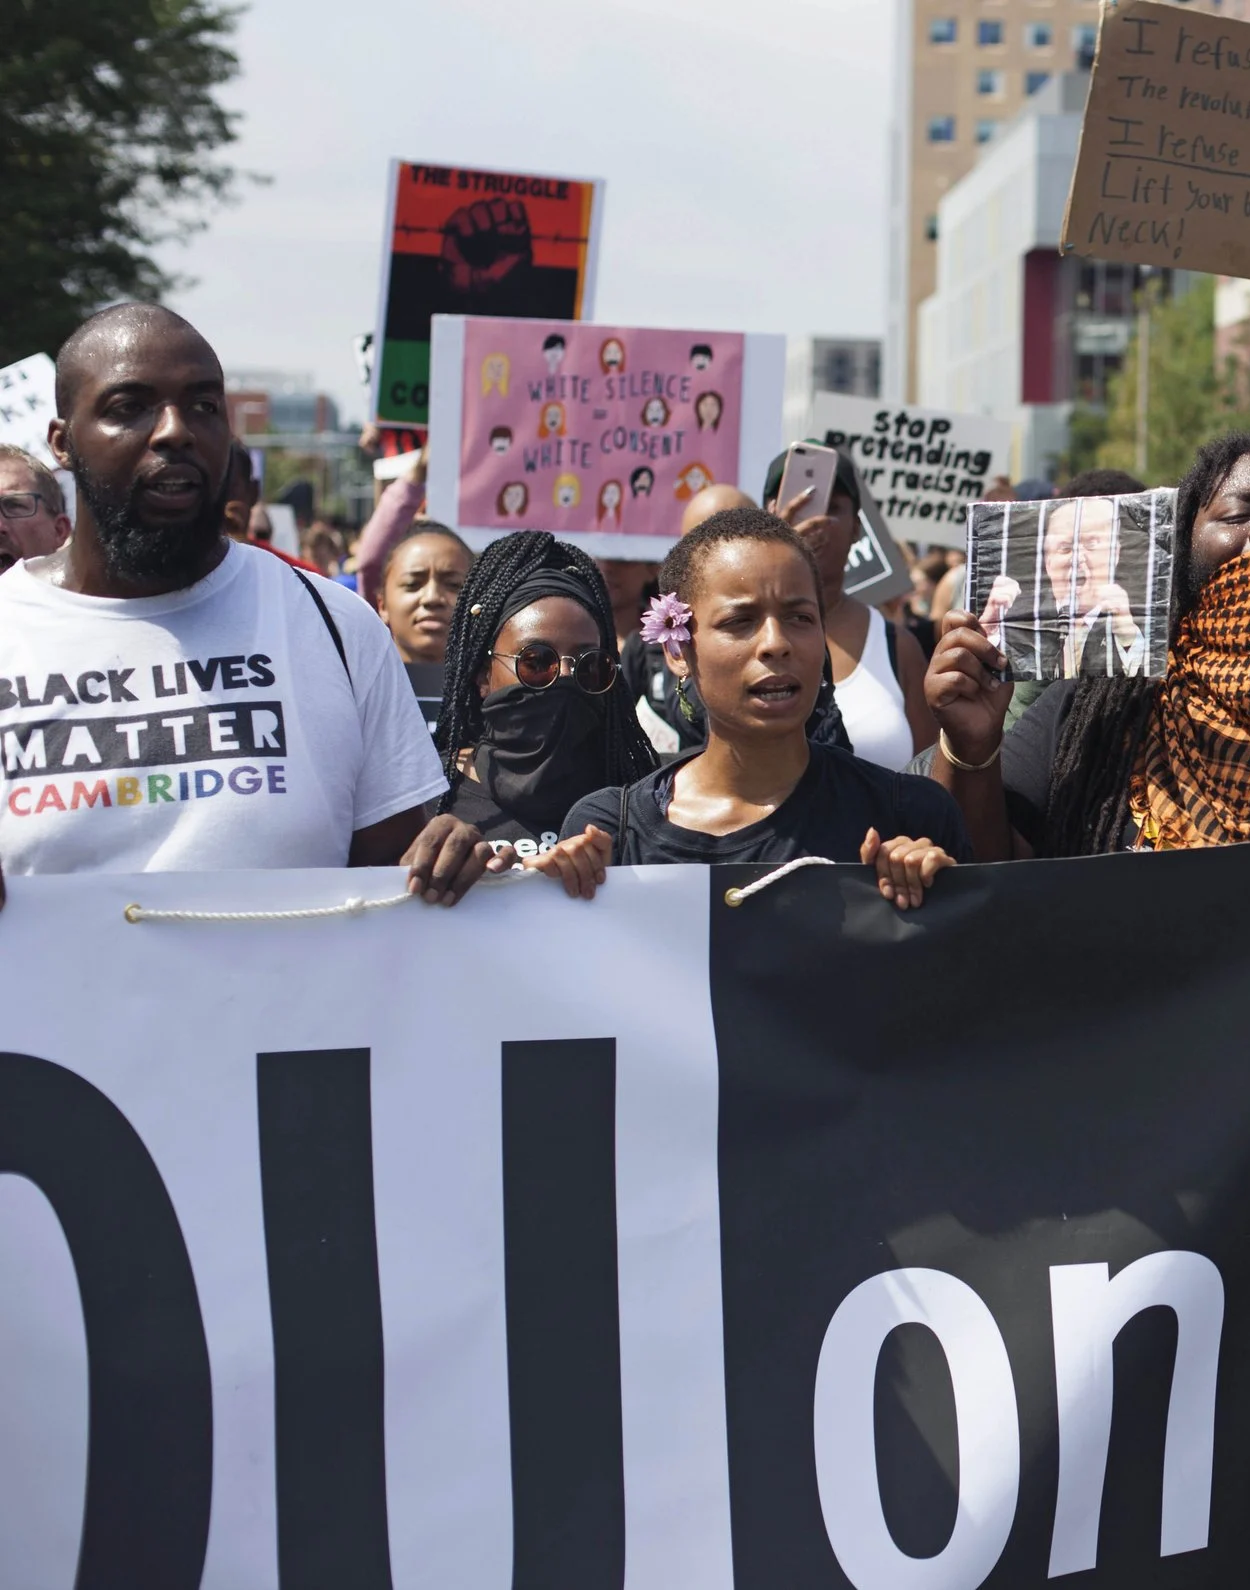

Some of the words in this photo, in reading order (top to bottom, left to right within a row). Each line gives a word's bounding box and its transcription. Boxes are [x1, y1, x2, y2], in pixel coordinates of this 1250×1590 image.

[1122, 17, 1159, 55] I
[1117, 75, 1168, 101] The
[1107, 116, 1145, 146] I
[1158, 124, 1240, 167] refuse
[409, 165, 450, 188] THE
[457, 170, 569, 201] STRUGGLE
[1101, 161, 1174, 205] Lift
[1185, 180, 1234, 214] your
[528, 375, 591, 403] WHITE
[605, 371, 692, 403] SILENCE
[523, 438, 593, 473] WHITE
[600, 425, 686, 461] CONSENT
[825, 429, 992, 476] pretending
[891, 467, 985, 499] racism
[0, 667, 140, 711] BLACK
[152, 654, 276, 698] LIVES
[4, 709, 281, 771] MATTER
[8, 765, 287, 817] CAMBRIDGE
